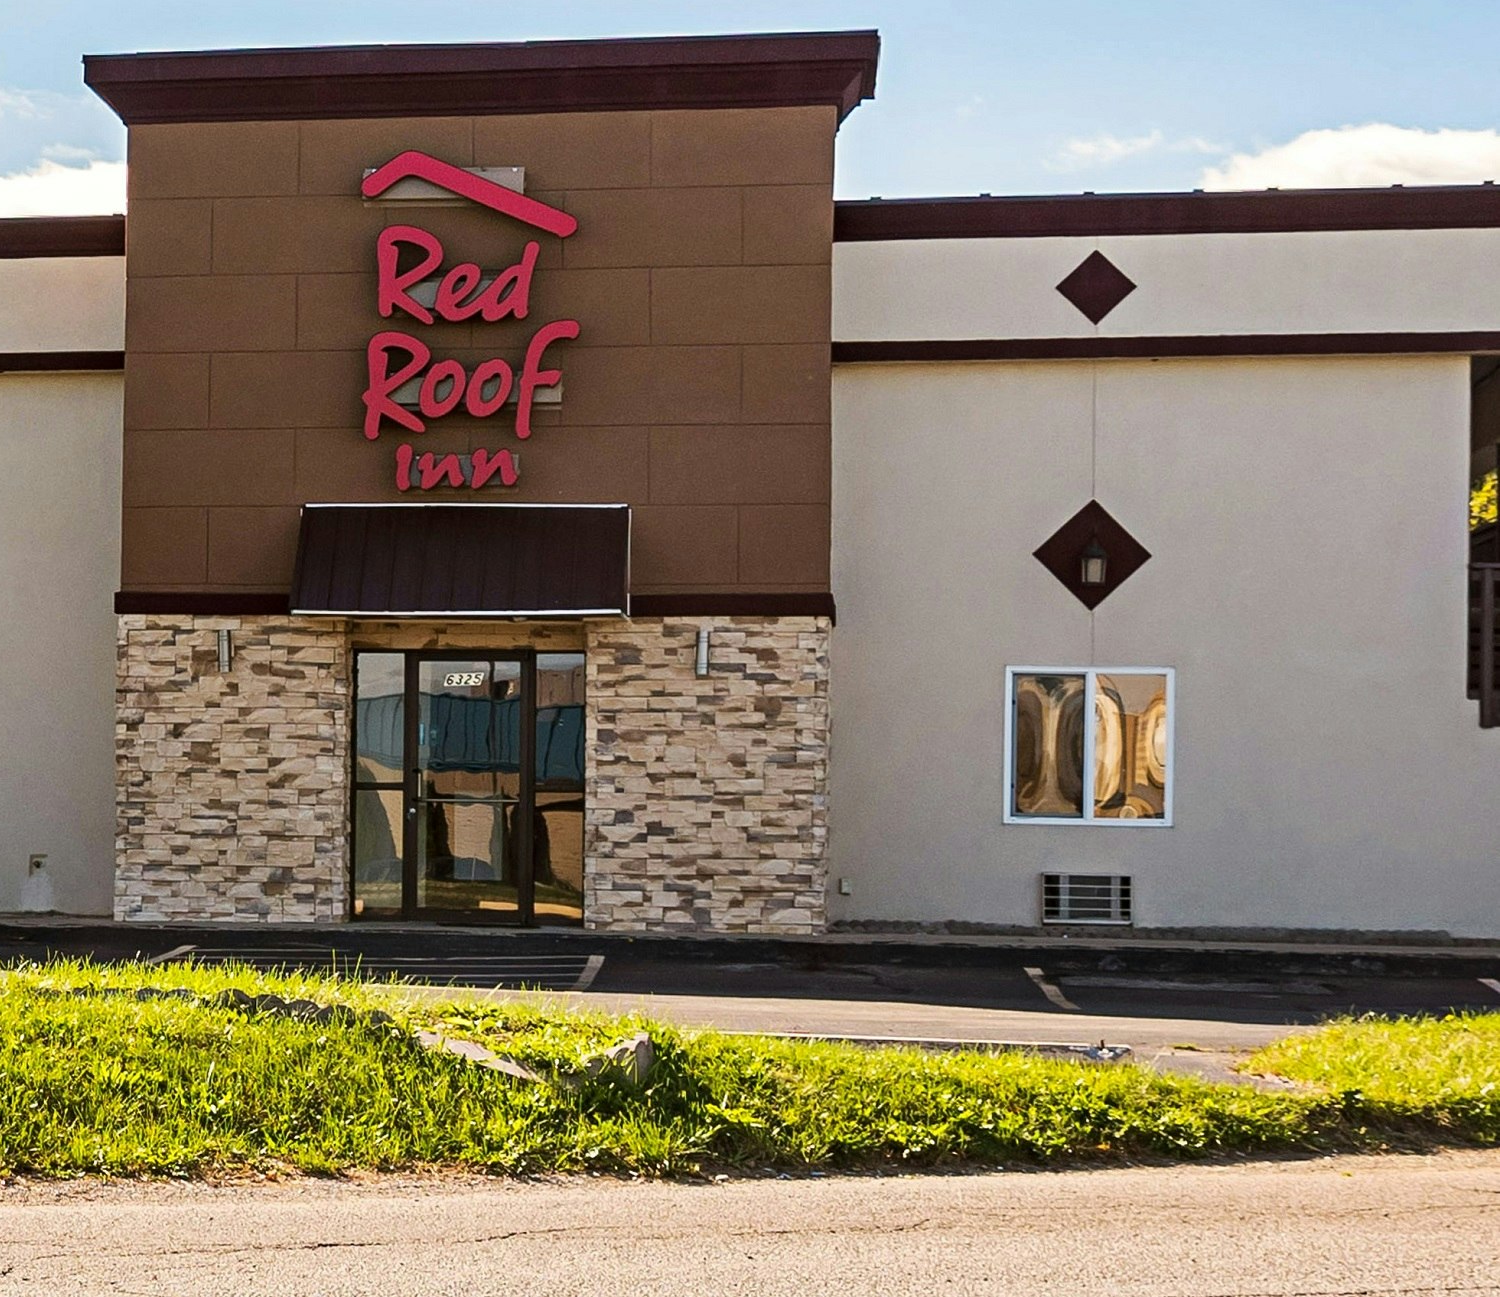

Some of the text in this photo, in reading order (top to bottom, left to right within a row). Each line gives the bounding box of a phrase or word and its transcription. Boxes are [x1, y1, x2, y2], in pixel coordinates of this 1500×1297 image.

[377, 224, 540, 325] Red
[361, 319, 580, 440] Roof
[446, 673, 482, 686] 6325
